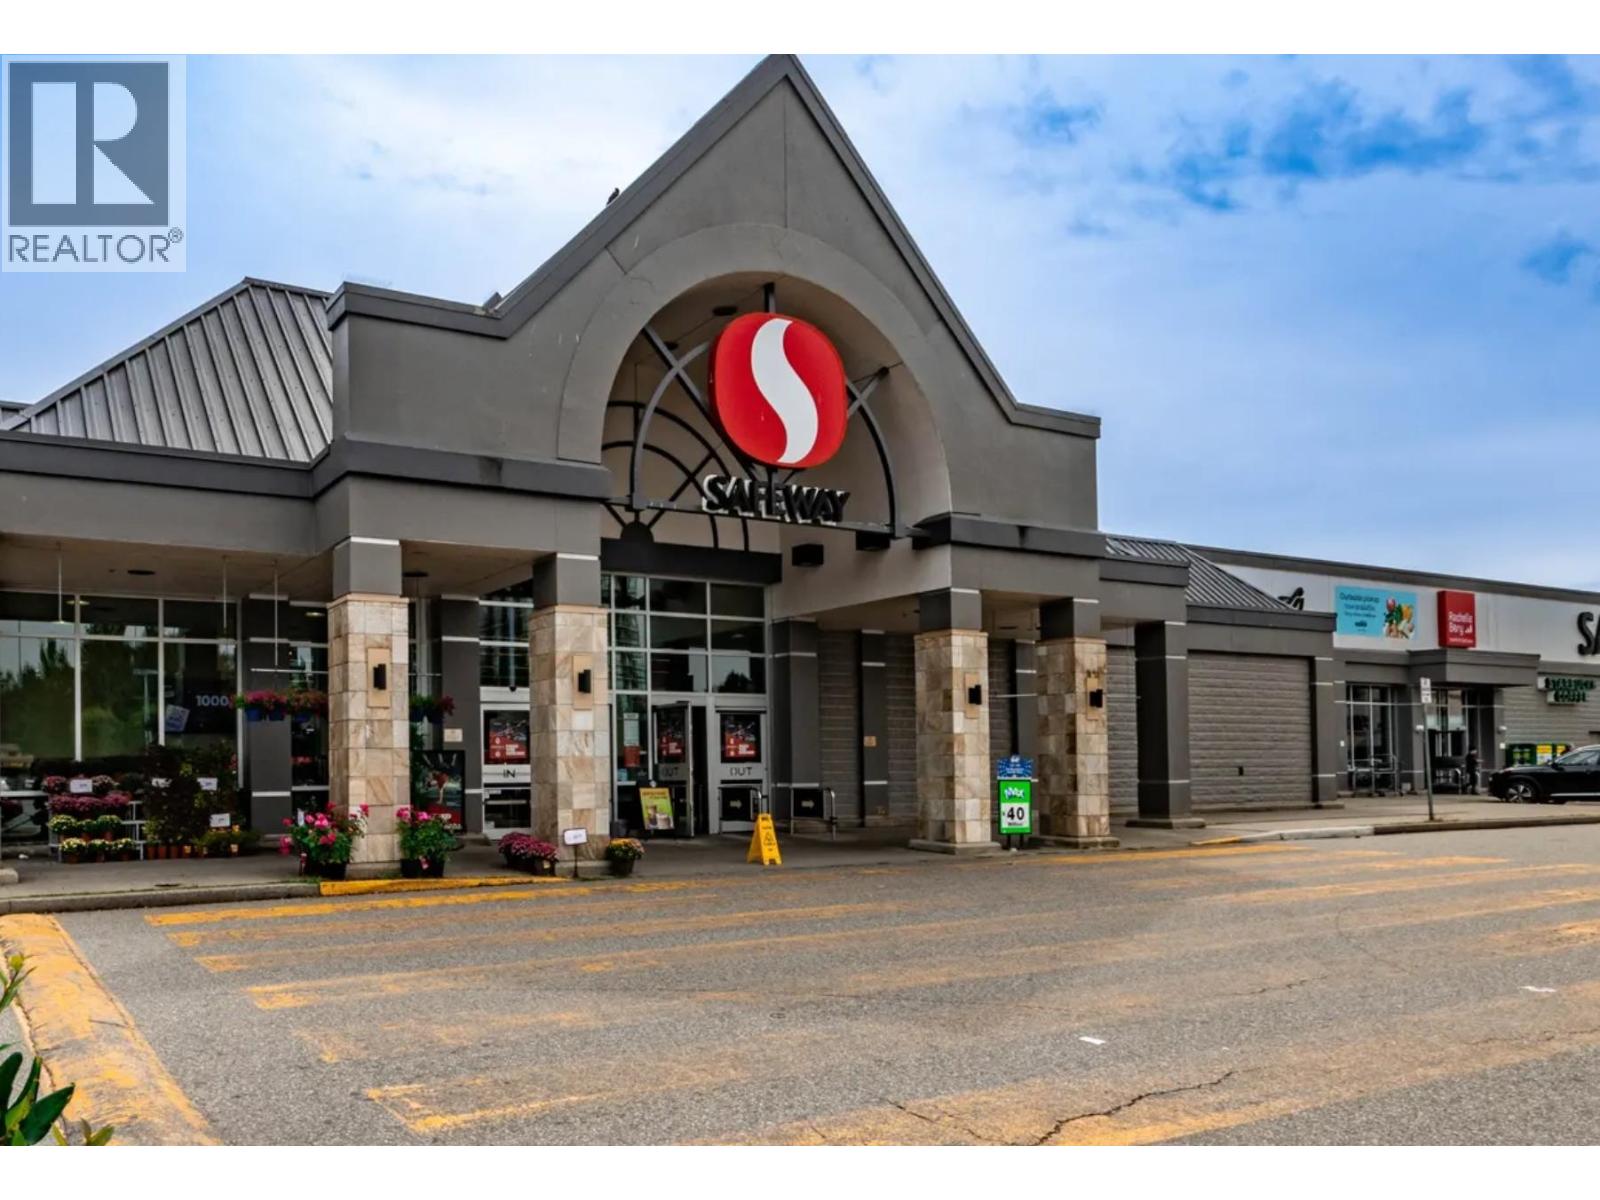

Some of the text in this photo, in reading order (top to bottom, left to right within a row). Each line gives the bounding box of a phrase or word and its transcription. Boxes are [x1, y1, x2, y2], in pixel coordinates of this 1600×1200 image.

[701, 474, 850, 526] SAFEWAY
[1577, 611, 1600, 656] S
[503, 769, 516, 778] IN
[730, 766, 753, 777] OUT
